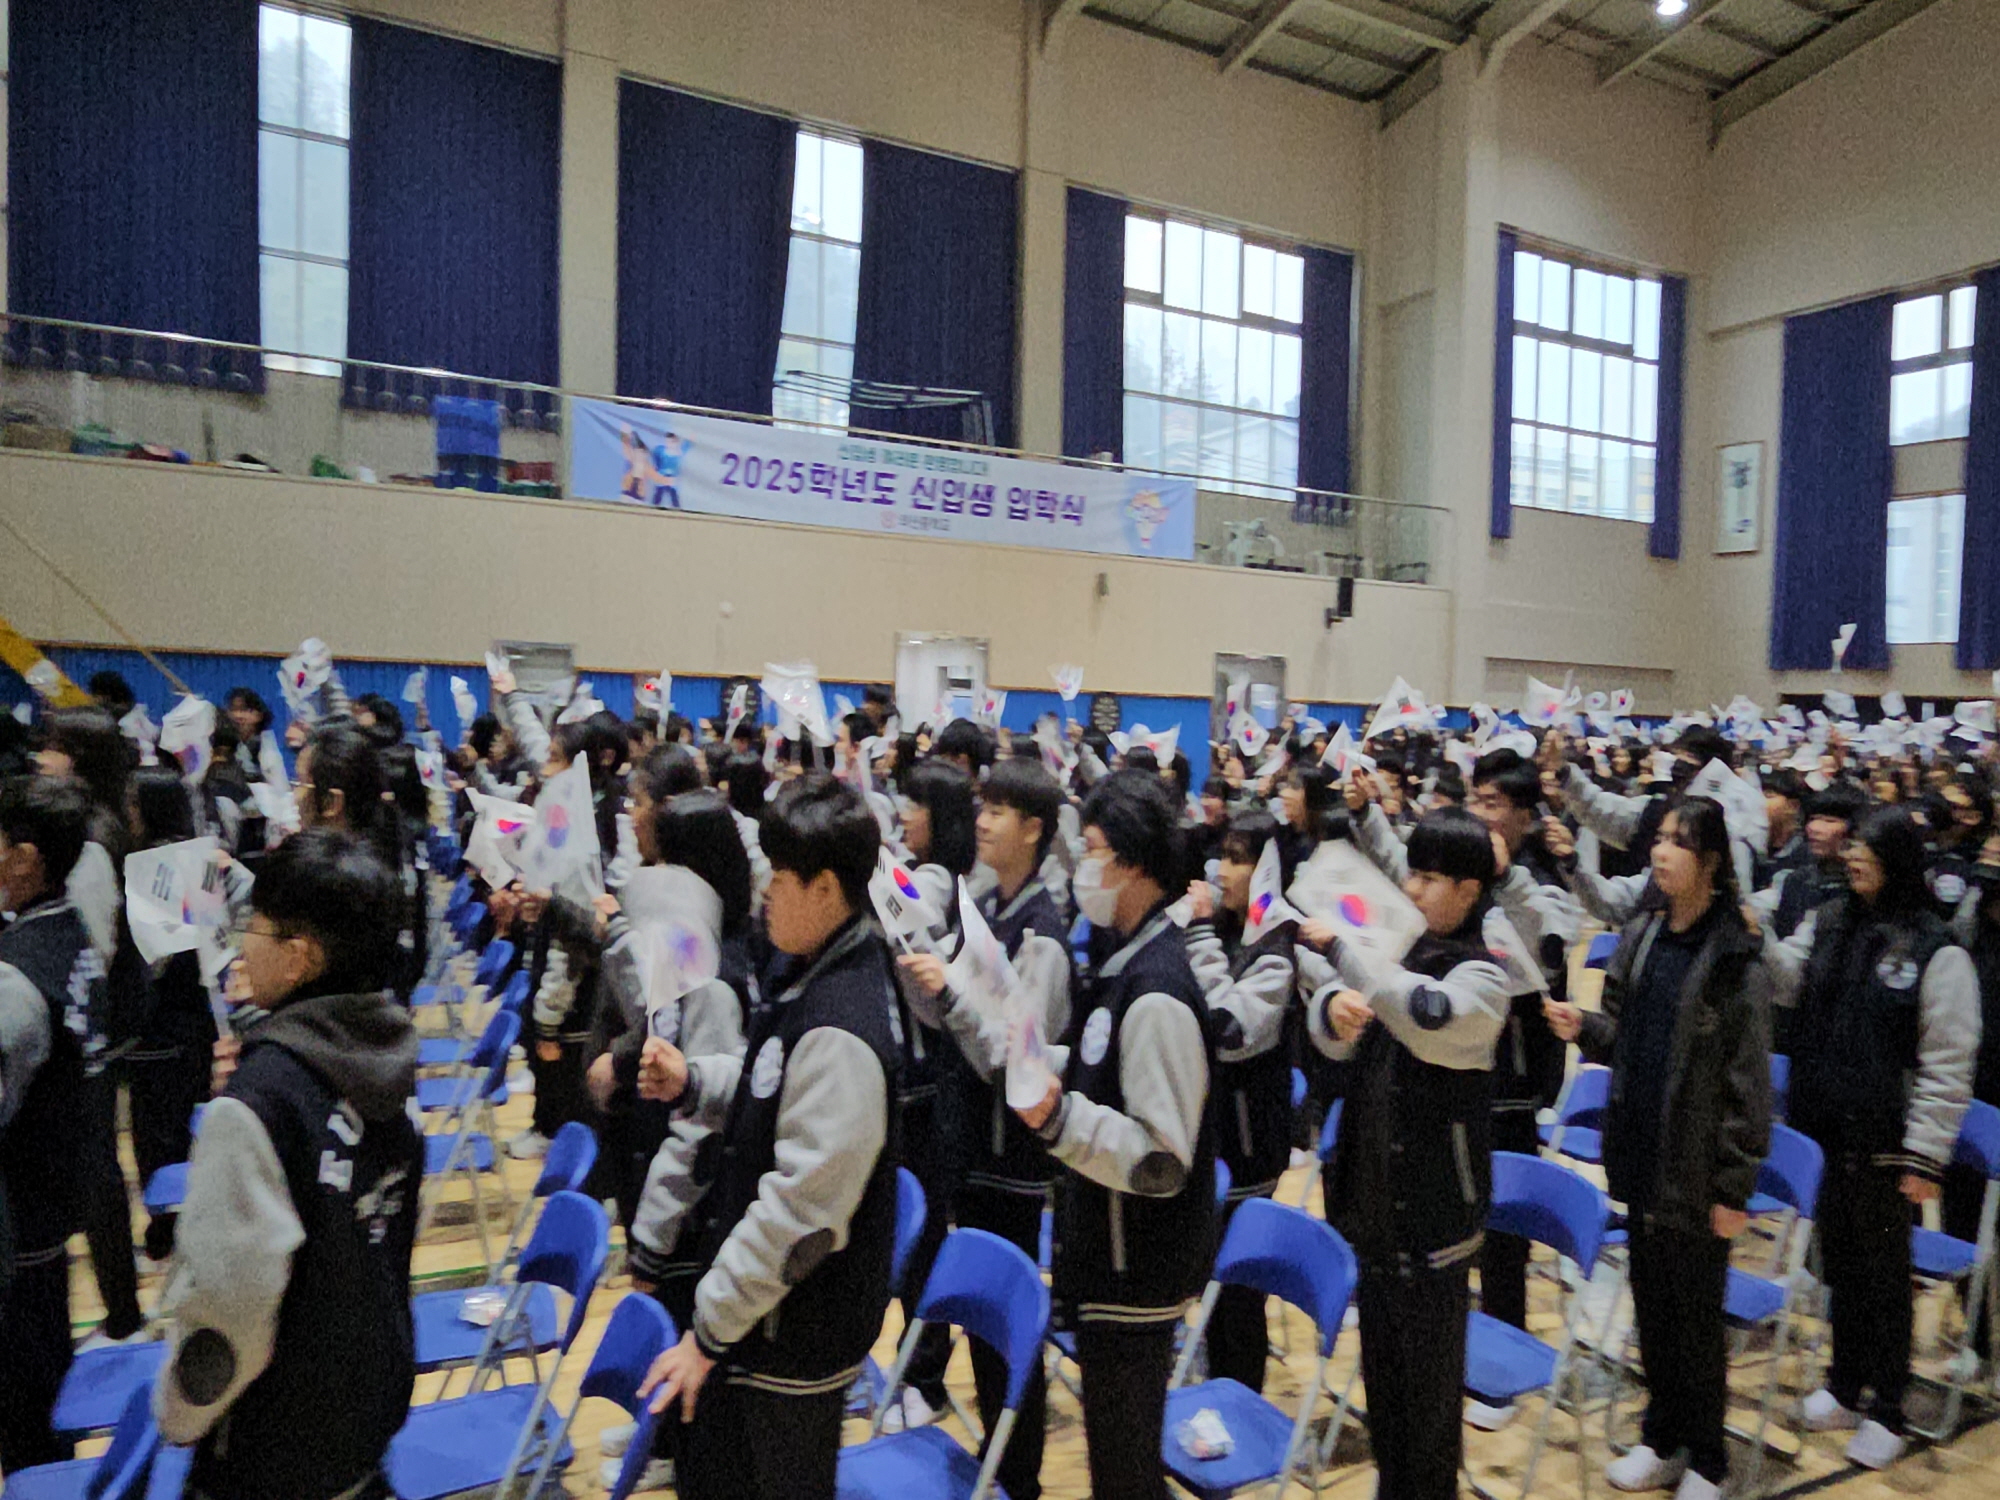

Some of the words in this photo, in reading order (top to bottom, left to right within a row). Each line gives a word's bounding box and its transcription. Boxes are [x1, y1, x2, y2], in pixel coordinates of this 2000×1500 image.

[721, 452, 897, 506] 2025학년도
[911, 475, 996, 518] 신입생
[1006, 486, 1087, 527] 입학식
